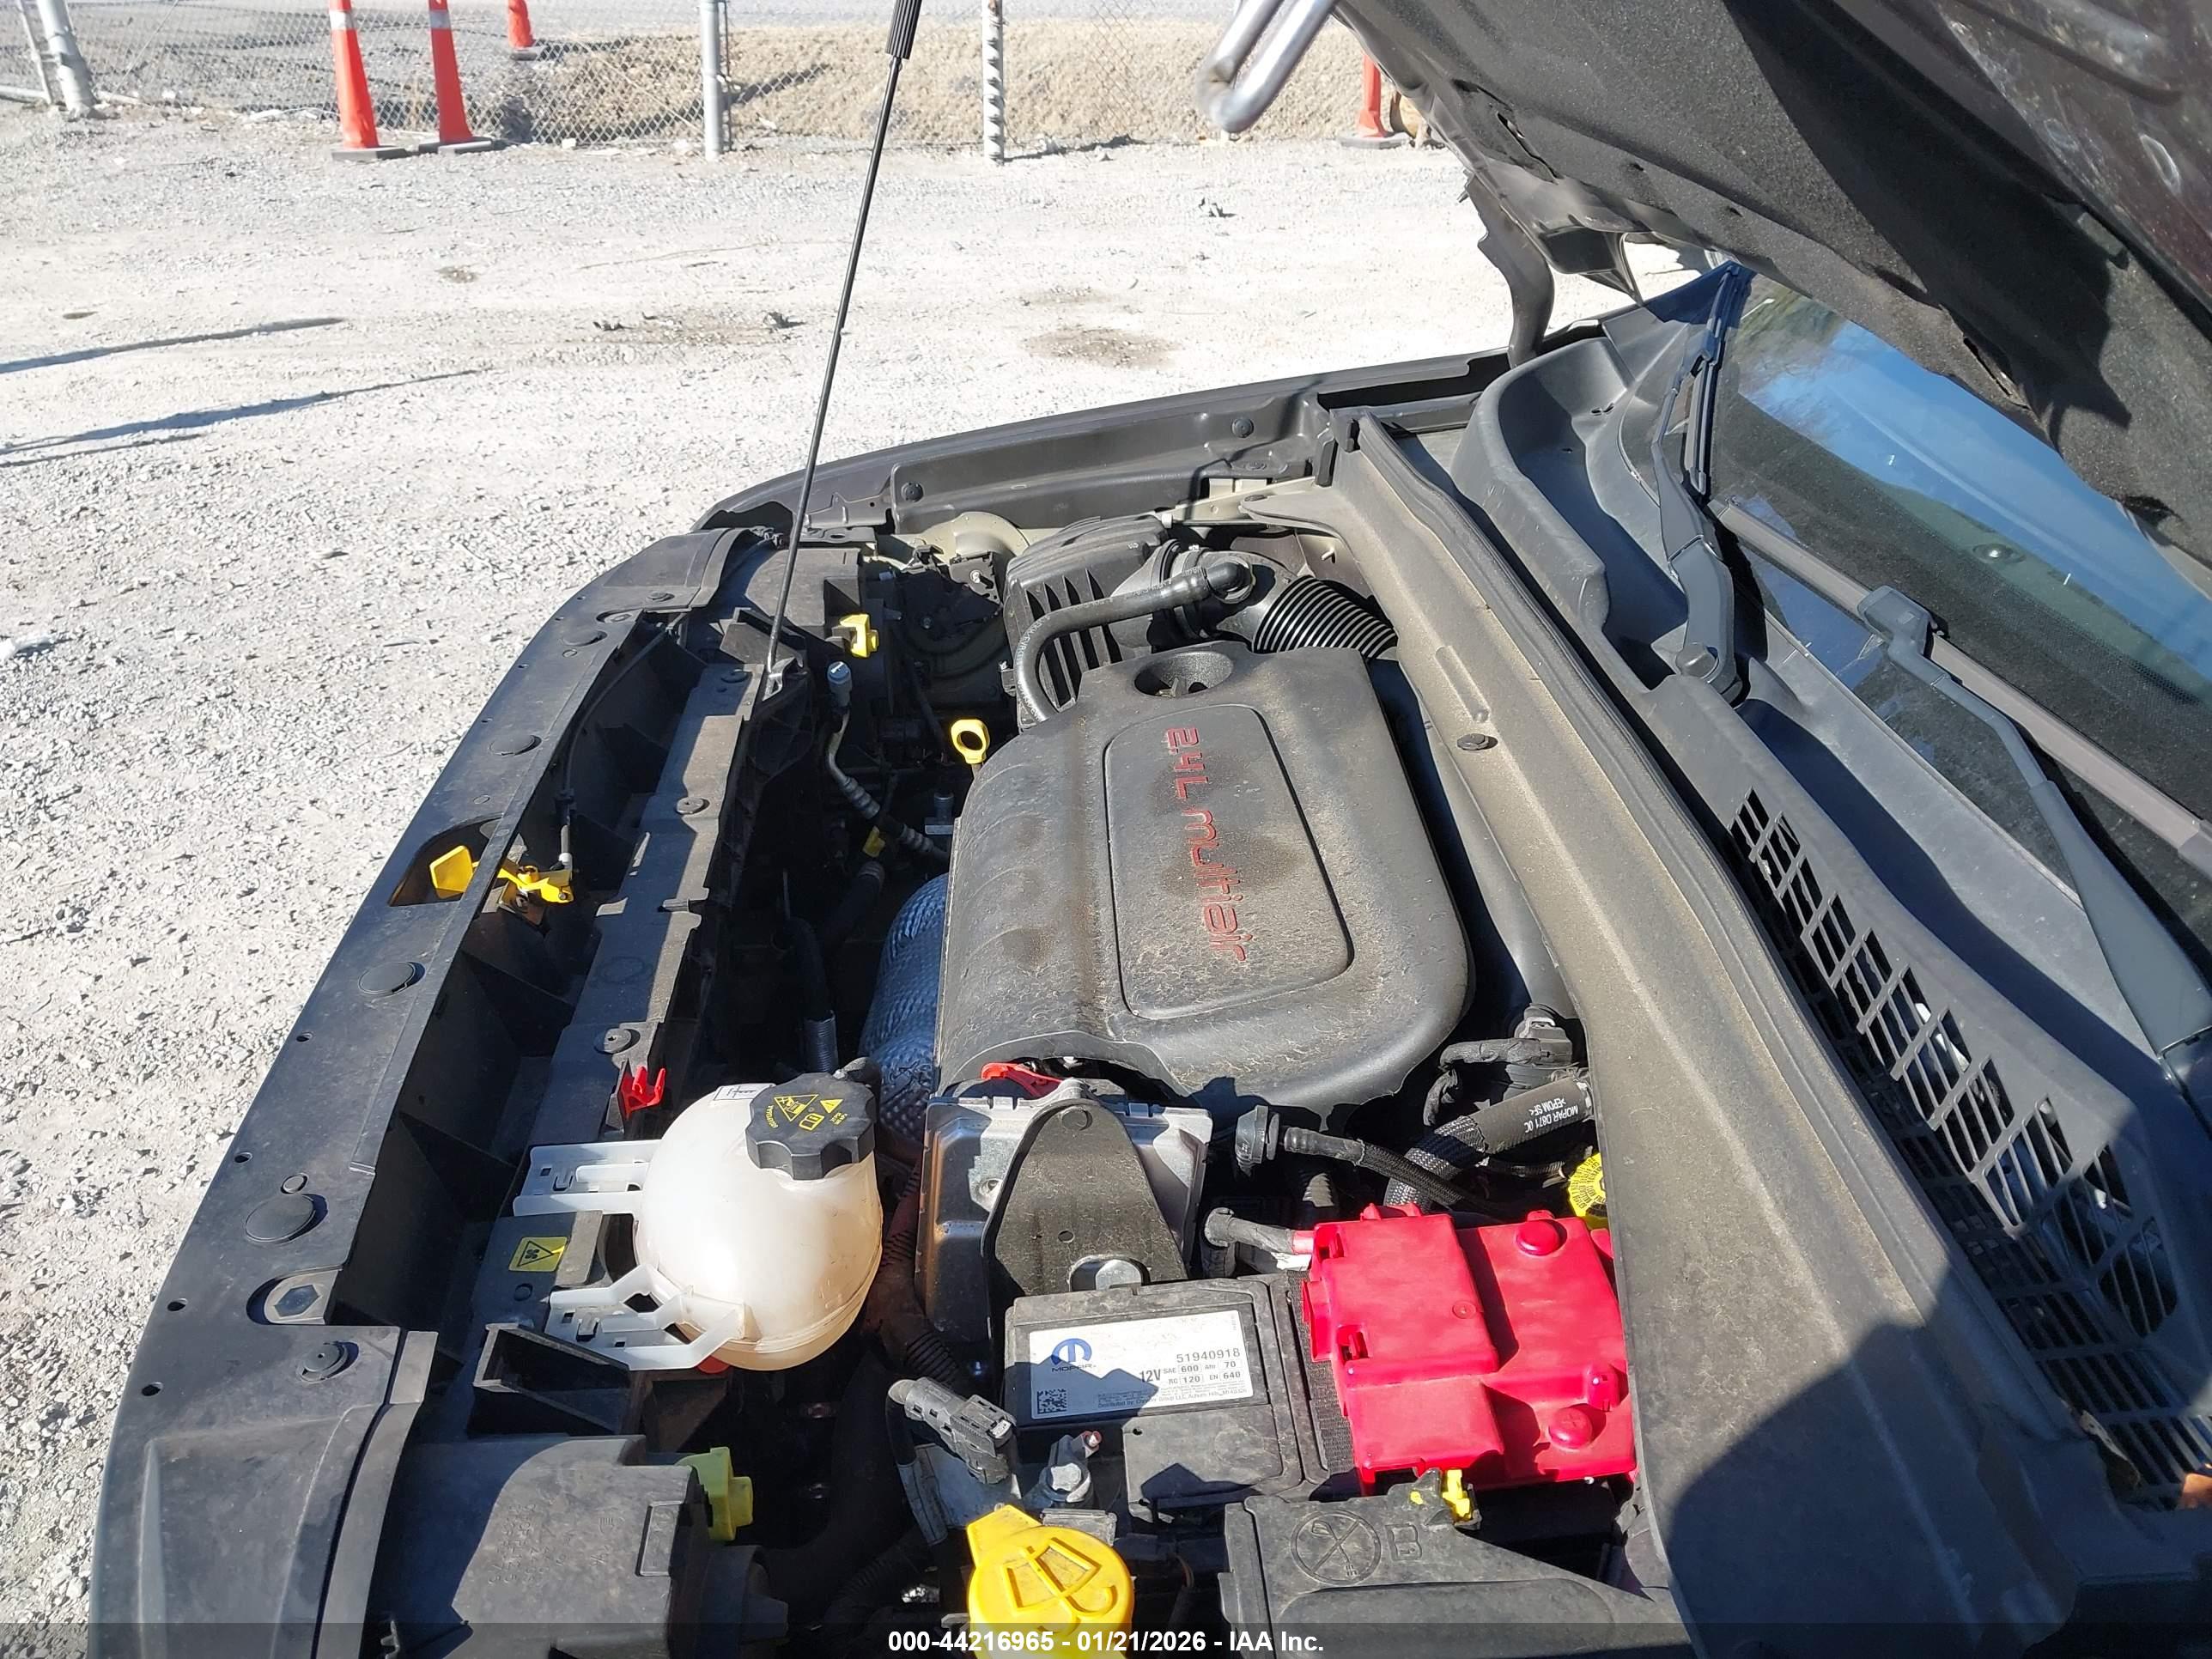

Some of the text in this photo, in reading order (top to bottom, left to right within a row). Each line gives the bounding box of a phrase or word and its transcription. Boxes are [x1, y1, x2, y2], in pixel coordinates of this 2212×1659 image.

[1181, 807, 1254, 963] multiair
[1553, 1104, 1578, 1122] MOPAR
[1176, 1348, 1240, 1363] 51940918
[1139, 1369, 1161, 1382] 12V
[1181, 1364, 1199, 1373] 600
